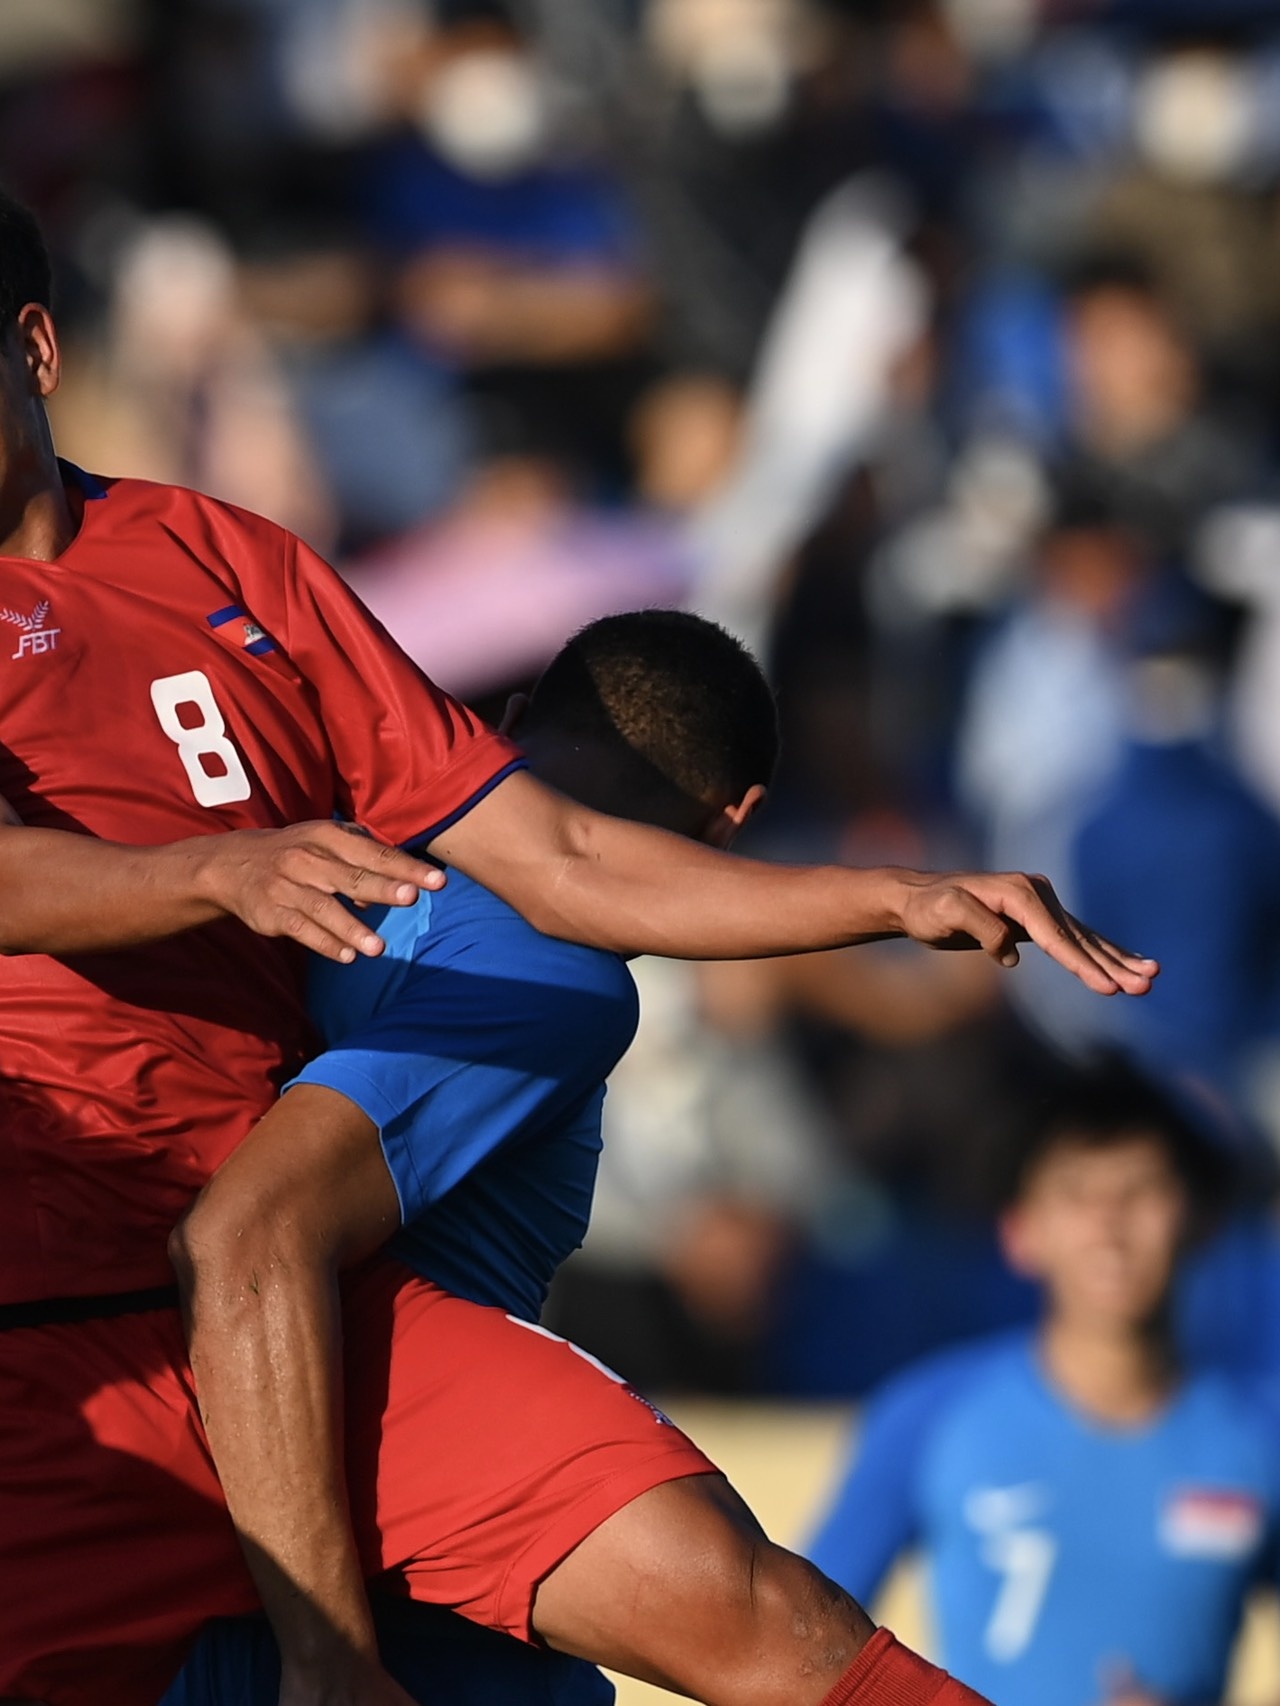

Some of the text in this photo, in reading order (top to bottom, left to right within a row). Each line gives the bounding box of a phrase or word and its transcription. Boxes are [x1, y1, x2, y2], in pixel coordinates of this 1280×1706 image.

[12, 629, 61, 660] FBT
[150, 669, 252, 808] 8
[978, 1526, 1058, 1664] 7
